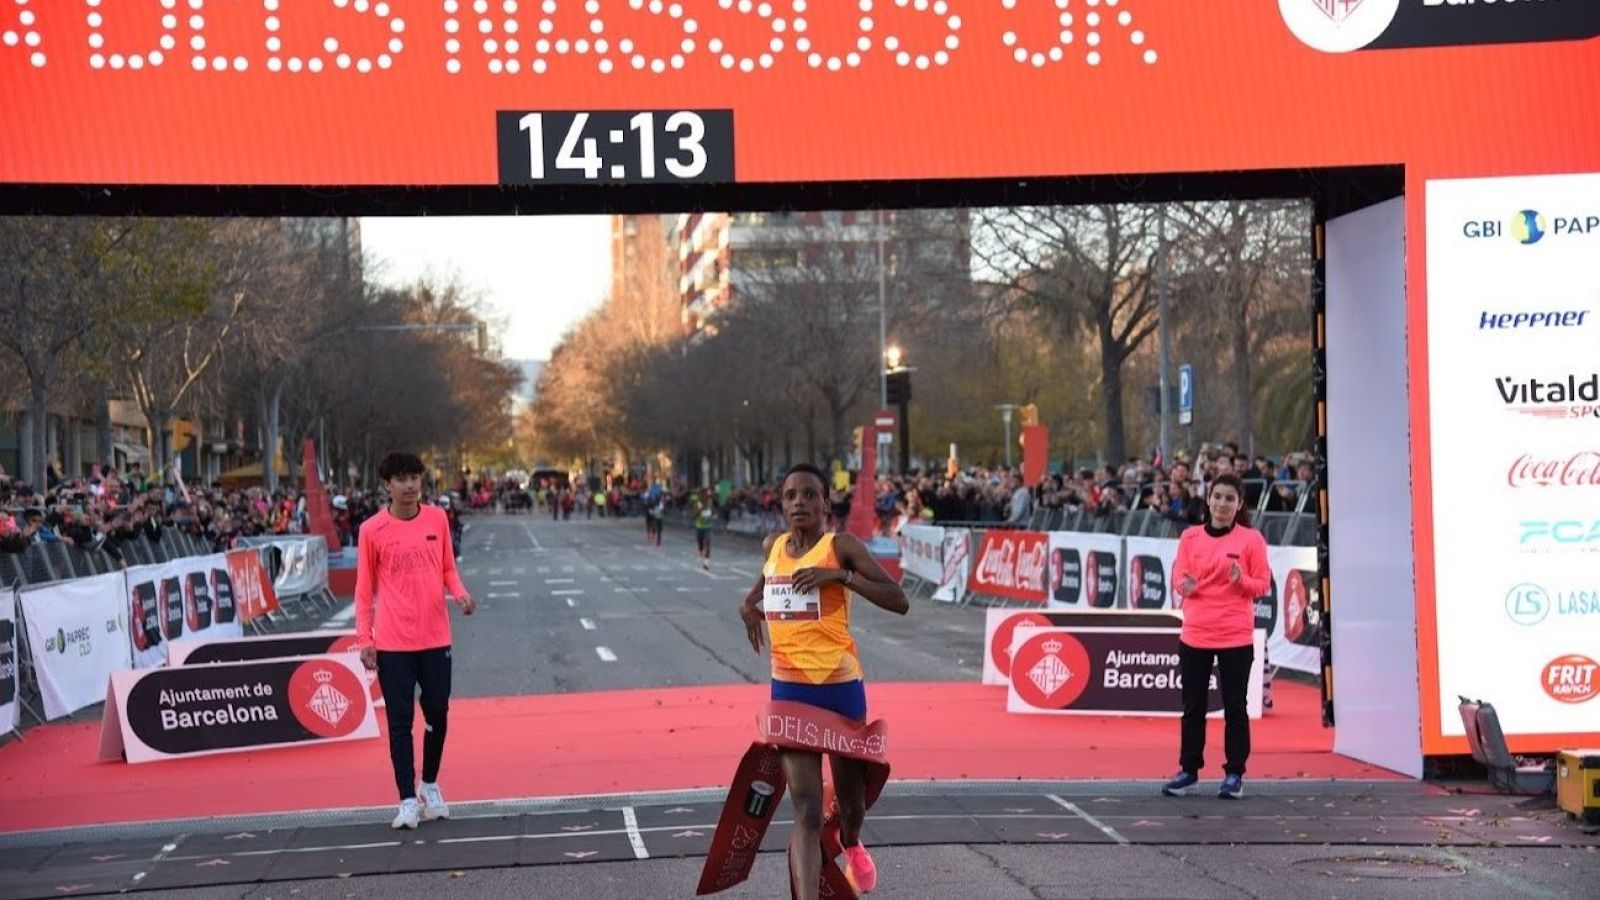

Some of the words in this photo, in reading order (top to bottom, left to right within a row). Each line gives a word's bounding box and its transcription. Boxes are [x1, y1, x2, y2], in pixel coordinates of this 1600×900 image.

[519, 111, 708, 180] 14:13
[1463, 220, 1502, 238] GBI
[784, 598, 791, 609] 2
[1548, 664, 1597, 686] FRIT
[159, 683, 251, 707] Ajuntament
[253, 682, 273, 697] de
[1552, 683, 1592, 695] RAVICH
[160, 701, 278, 730] Barcelona
[767, 714, 819, 748] DELS
